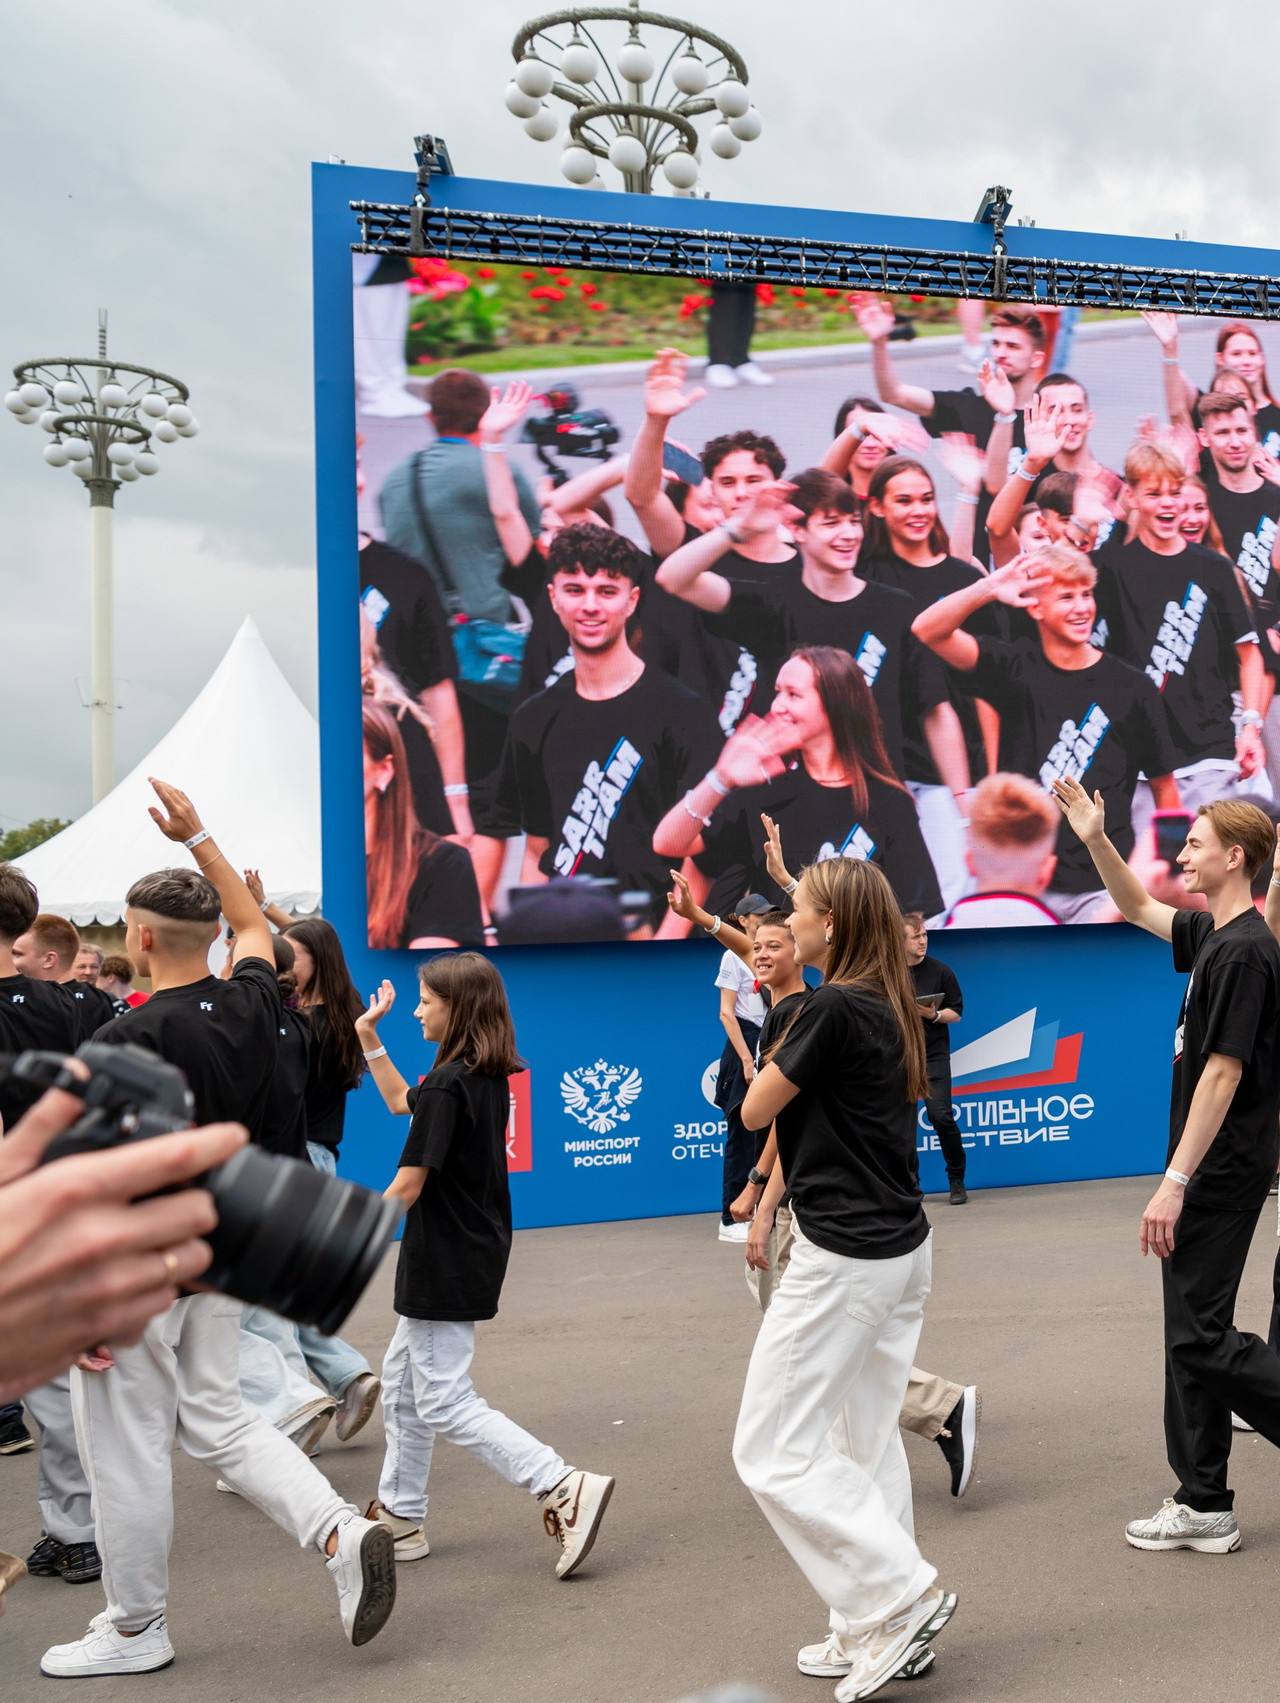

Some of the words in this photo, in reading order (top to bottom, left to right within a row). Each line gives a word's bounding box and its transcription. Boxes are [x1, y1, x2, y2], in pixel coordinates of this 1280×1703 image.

[1145, 600, 1186, 689] SARR
[553, 760, 605, 877] SARR
[582, 739, 643, 860] TEAM
[564, 1136, 641, 1153] МИНСПОРТ
[673, 1120, 729, 1140] ЗДОР
[573, 1152, 632, 1168] РОССИИ
